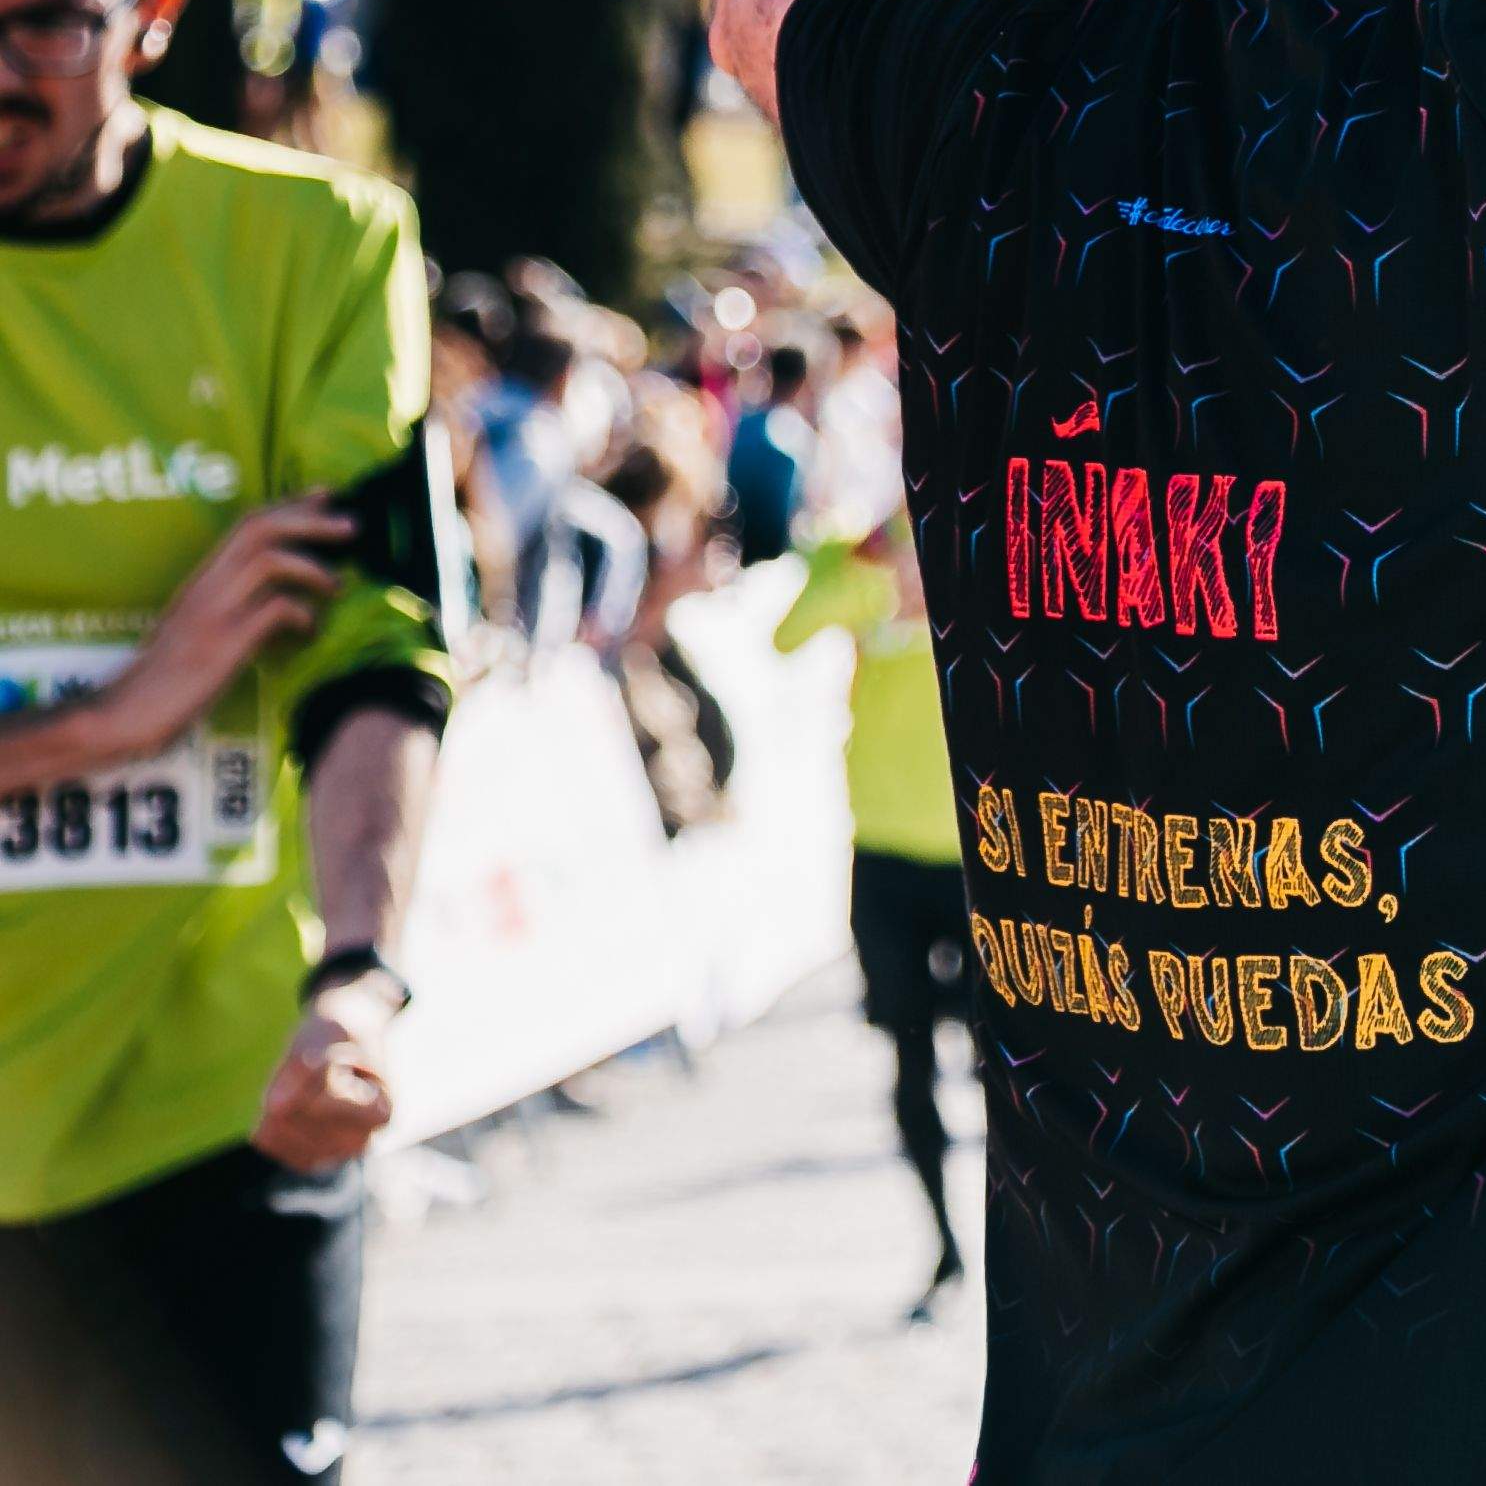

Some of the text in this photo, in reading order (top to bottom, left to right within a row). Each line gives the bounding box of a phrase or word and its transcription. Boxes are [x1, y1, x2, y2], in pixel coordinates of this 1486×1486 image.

[6, 439, 236, 507] MetLife
[0, 782, 182, 861] 3813
[979, 784, 1400, 924] SI ENTRENAS,
[970, 905, 1475, 1051] QUIZÁS PUEDAS
